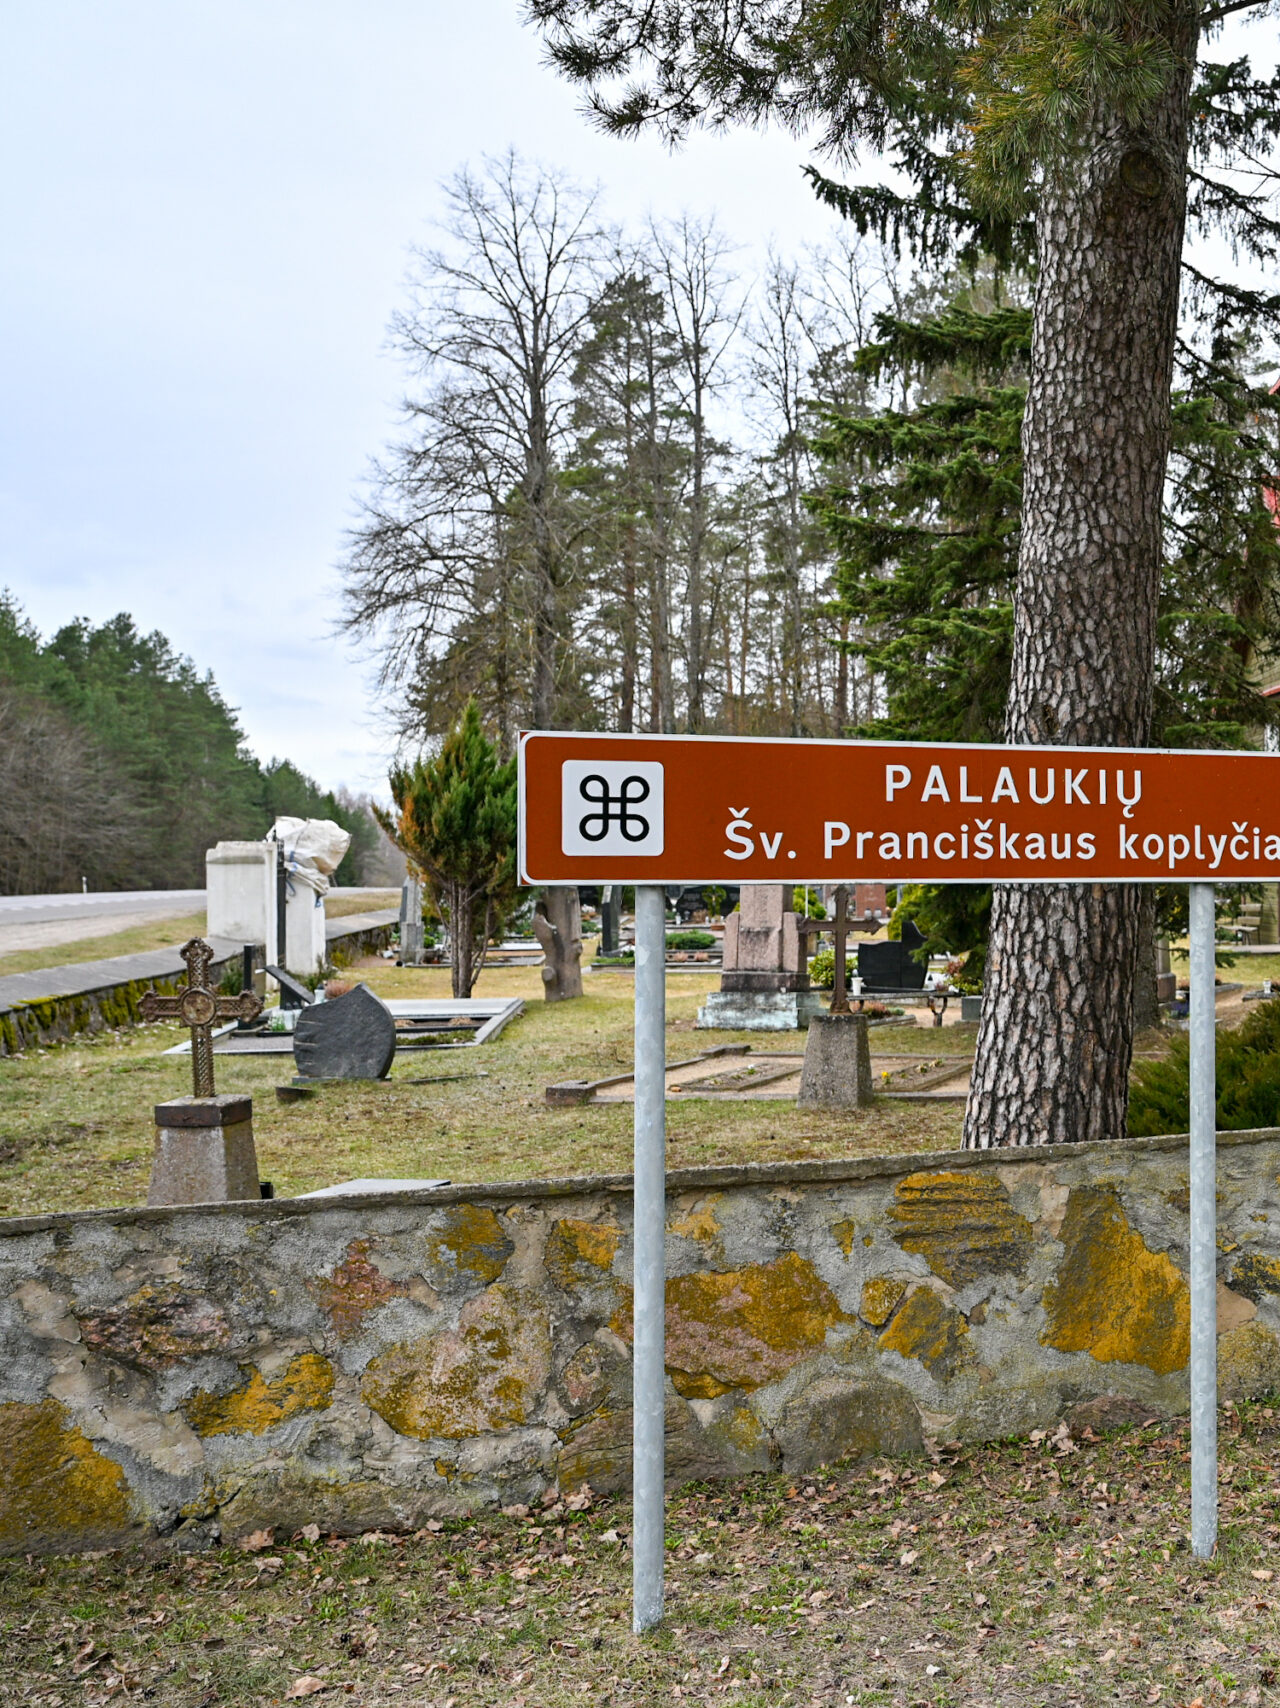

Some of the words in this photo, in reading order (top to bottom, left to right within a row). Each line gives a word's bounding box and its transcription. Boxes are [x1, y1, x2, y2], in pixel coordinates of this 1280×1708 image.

[885, 764, 1142, 819] PALAUKIŲ
[723, 807, 797, 861] Šv.
[823, 818, 1096, 861] Pranciškaus
